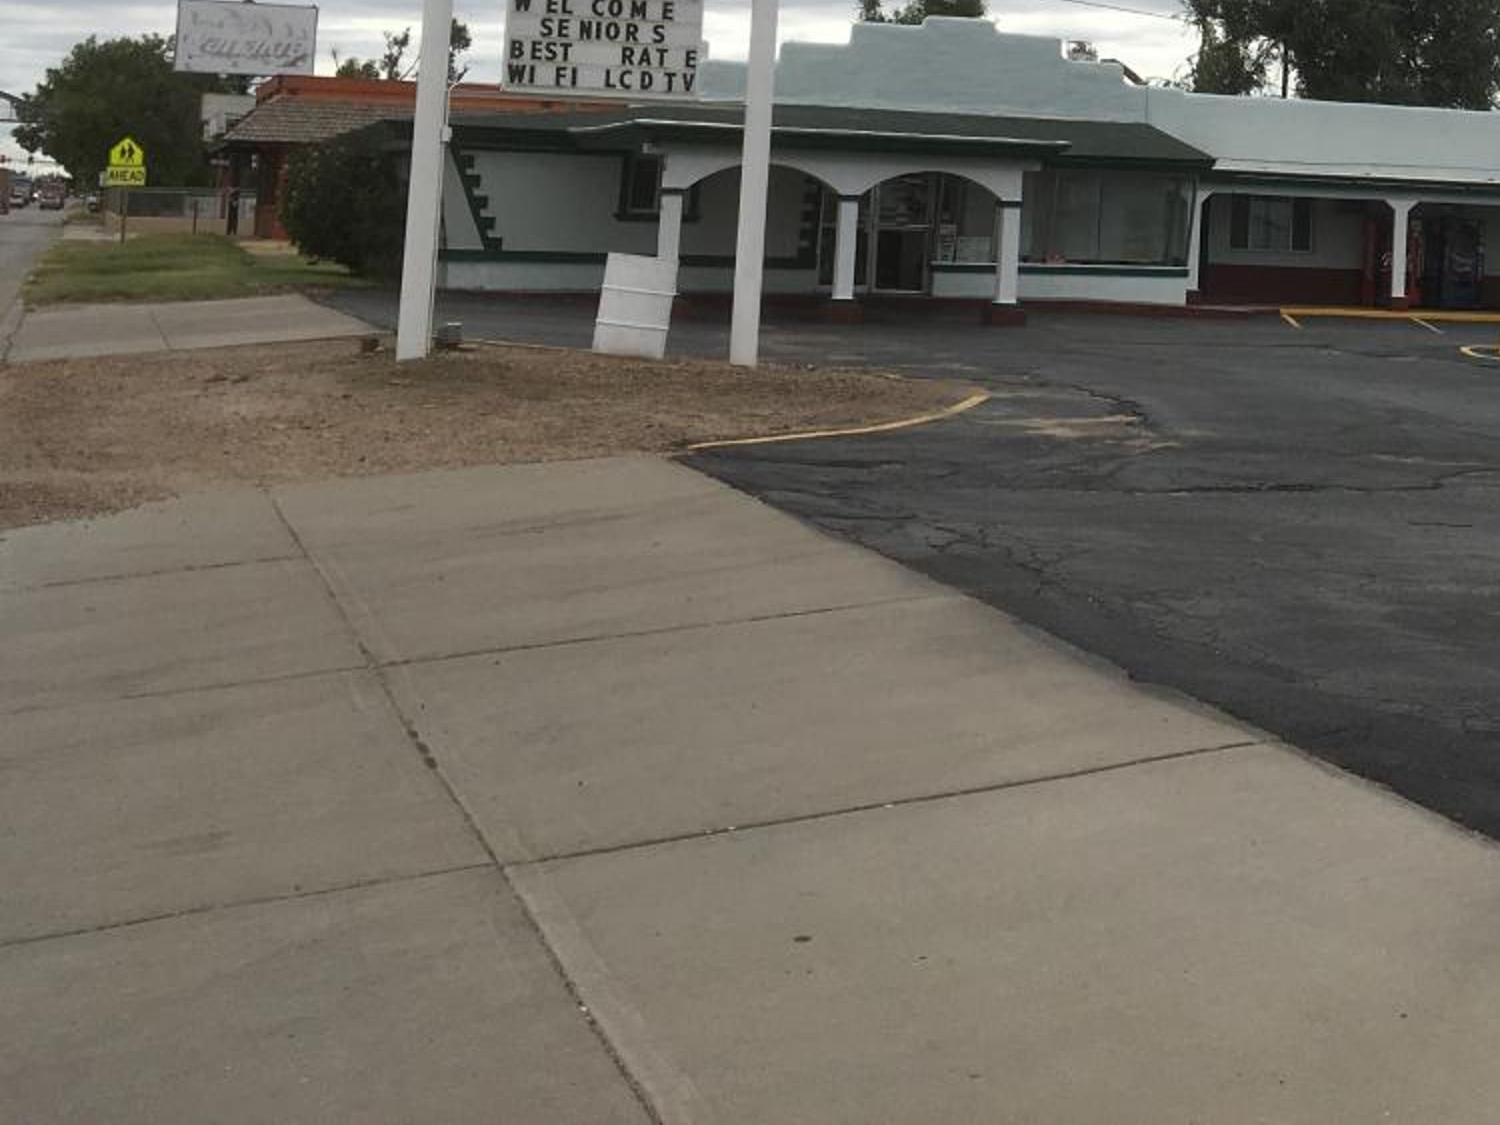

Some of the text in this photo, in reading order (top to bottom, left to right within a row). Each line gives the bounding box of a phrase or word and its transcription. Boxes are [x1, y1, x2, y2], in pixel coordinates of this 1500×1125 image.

[539, 18, 666, 44] SENIORS
[509, 40, 698, 69] BEST RATE
[109, 170, 145, 182] AHEAD
